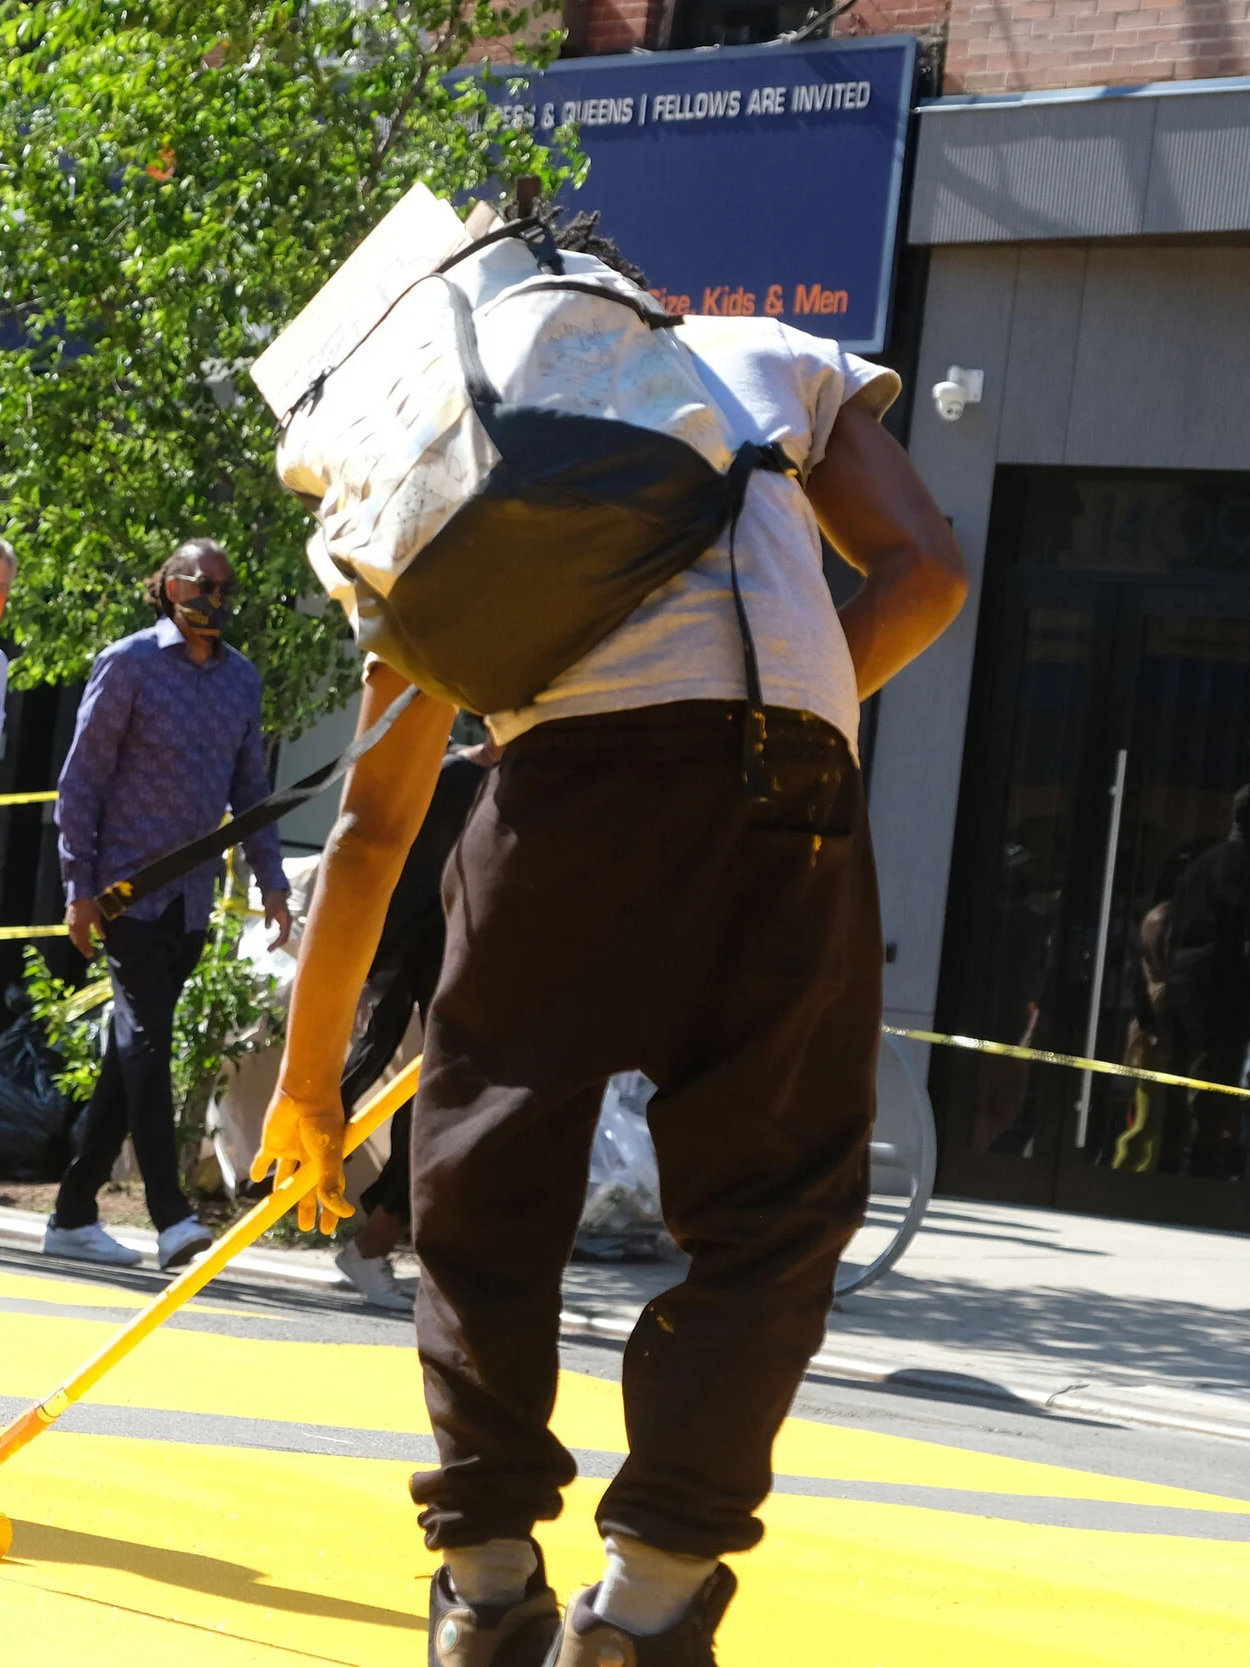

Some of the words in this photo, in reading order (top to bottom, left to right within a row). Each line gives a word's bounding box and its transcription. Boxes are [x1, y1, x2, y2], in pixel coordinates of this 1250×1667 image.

[562, 97, 634, 126] QUEENS
[652, 90, 741, 122] FELLOWS
[746, 86, 787, 116] ARE
[792, 80, 871, 113] INVITED
[703, 285, 756, 317] Kids
[763, 284, 785, 316] &
[793, 283, 849, 316] Men
